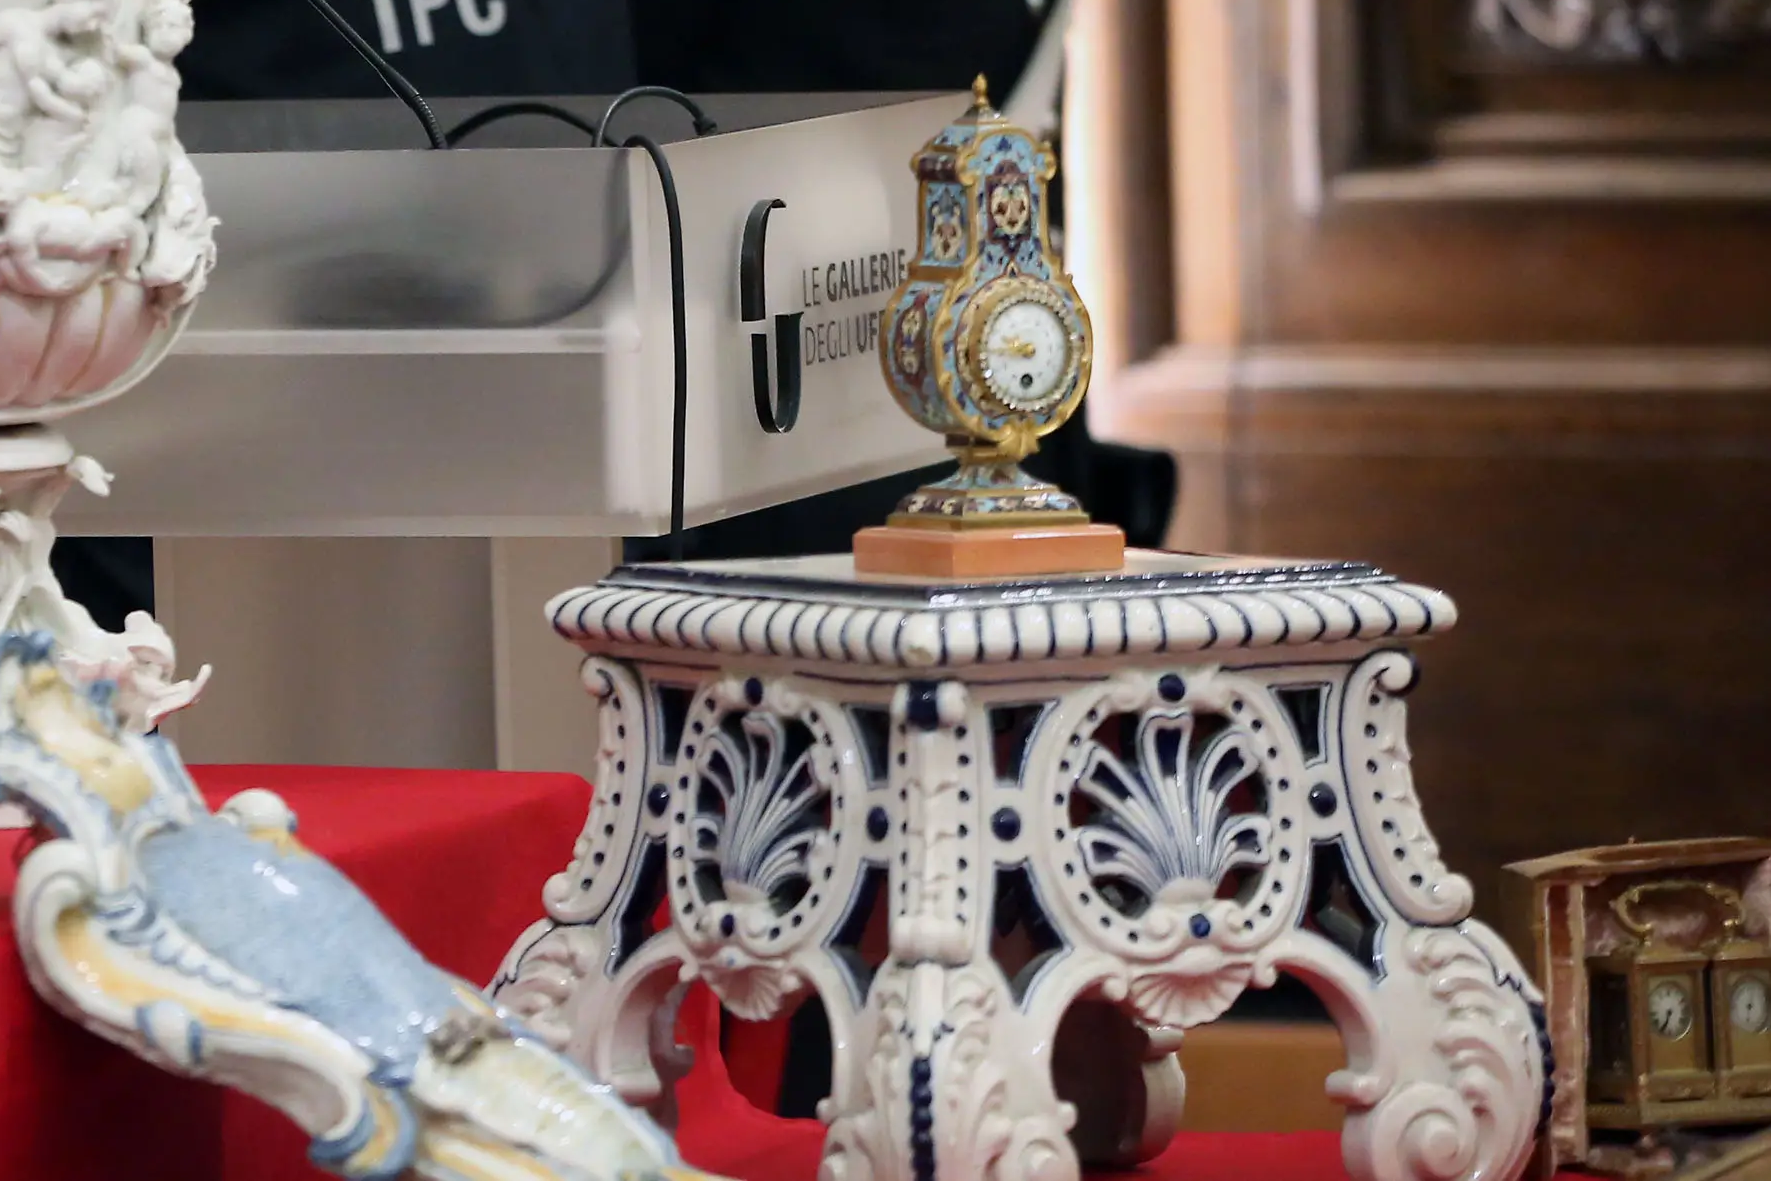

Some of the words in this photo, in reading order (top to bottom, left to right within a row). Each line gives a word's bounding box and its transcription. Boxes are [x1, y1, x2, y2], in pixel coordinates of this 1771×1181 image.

[802, 266, 821, 308] LE
[826, 248, 906, 303] GALLERIE
[804, 316, 851, 367] DEGLI
[855, 310, 885, 354] UF
